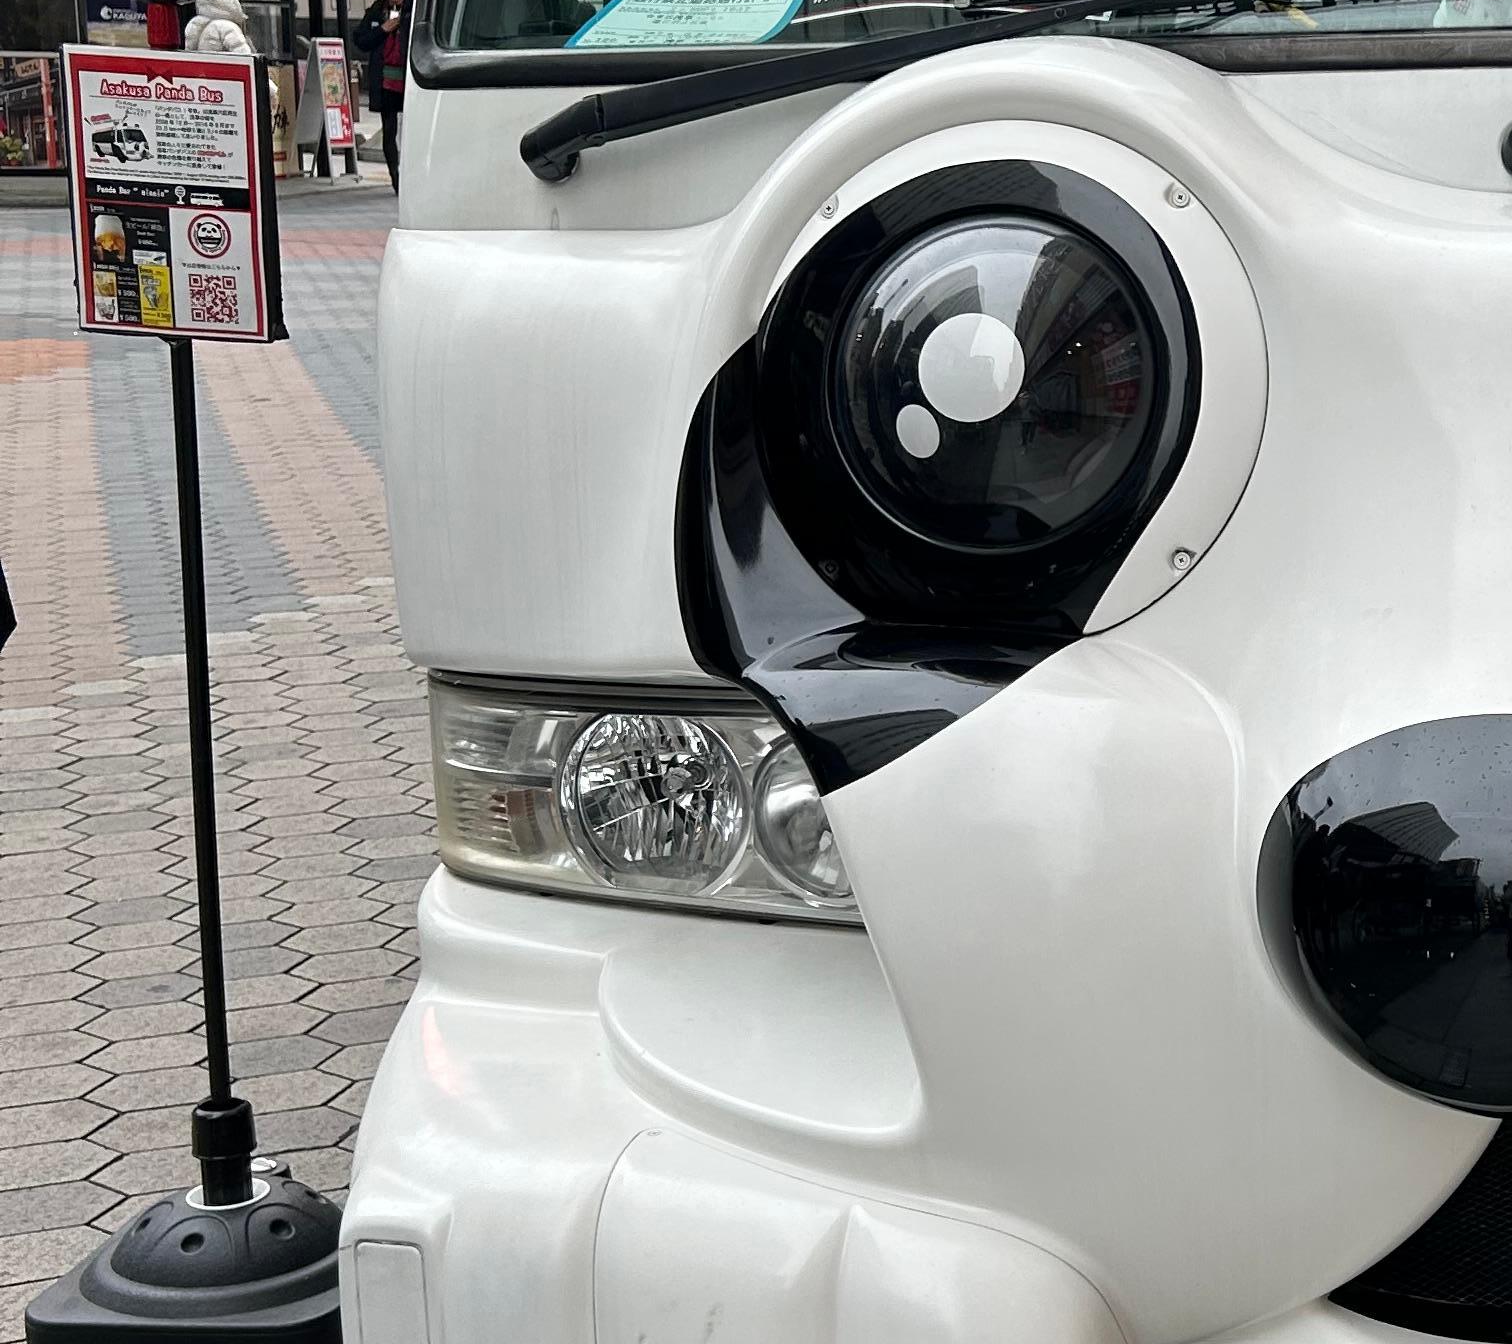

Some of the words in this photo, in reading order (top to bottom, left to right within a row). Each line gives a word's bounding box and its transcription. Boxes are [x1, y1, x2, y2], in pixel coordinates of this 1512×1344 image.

[99, 78, 151, 98] Asakusa
[155, 82, 195, 102] Panda
[198, 85, 224, 104] Bus
